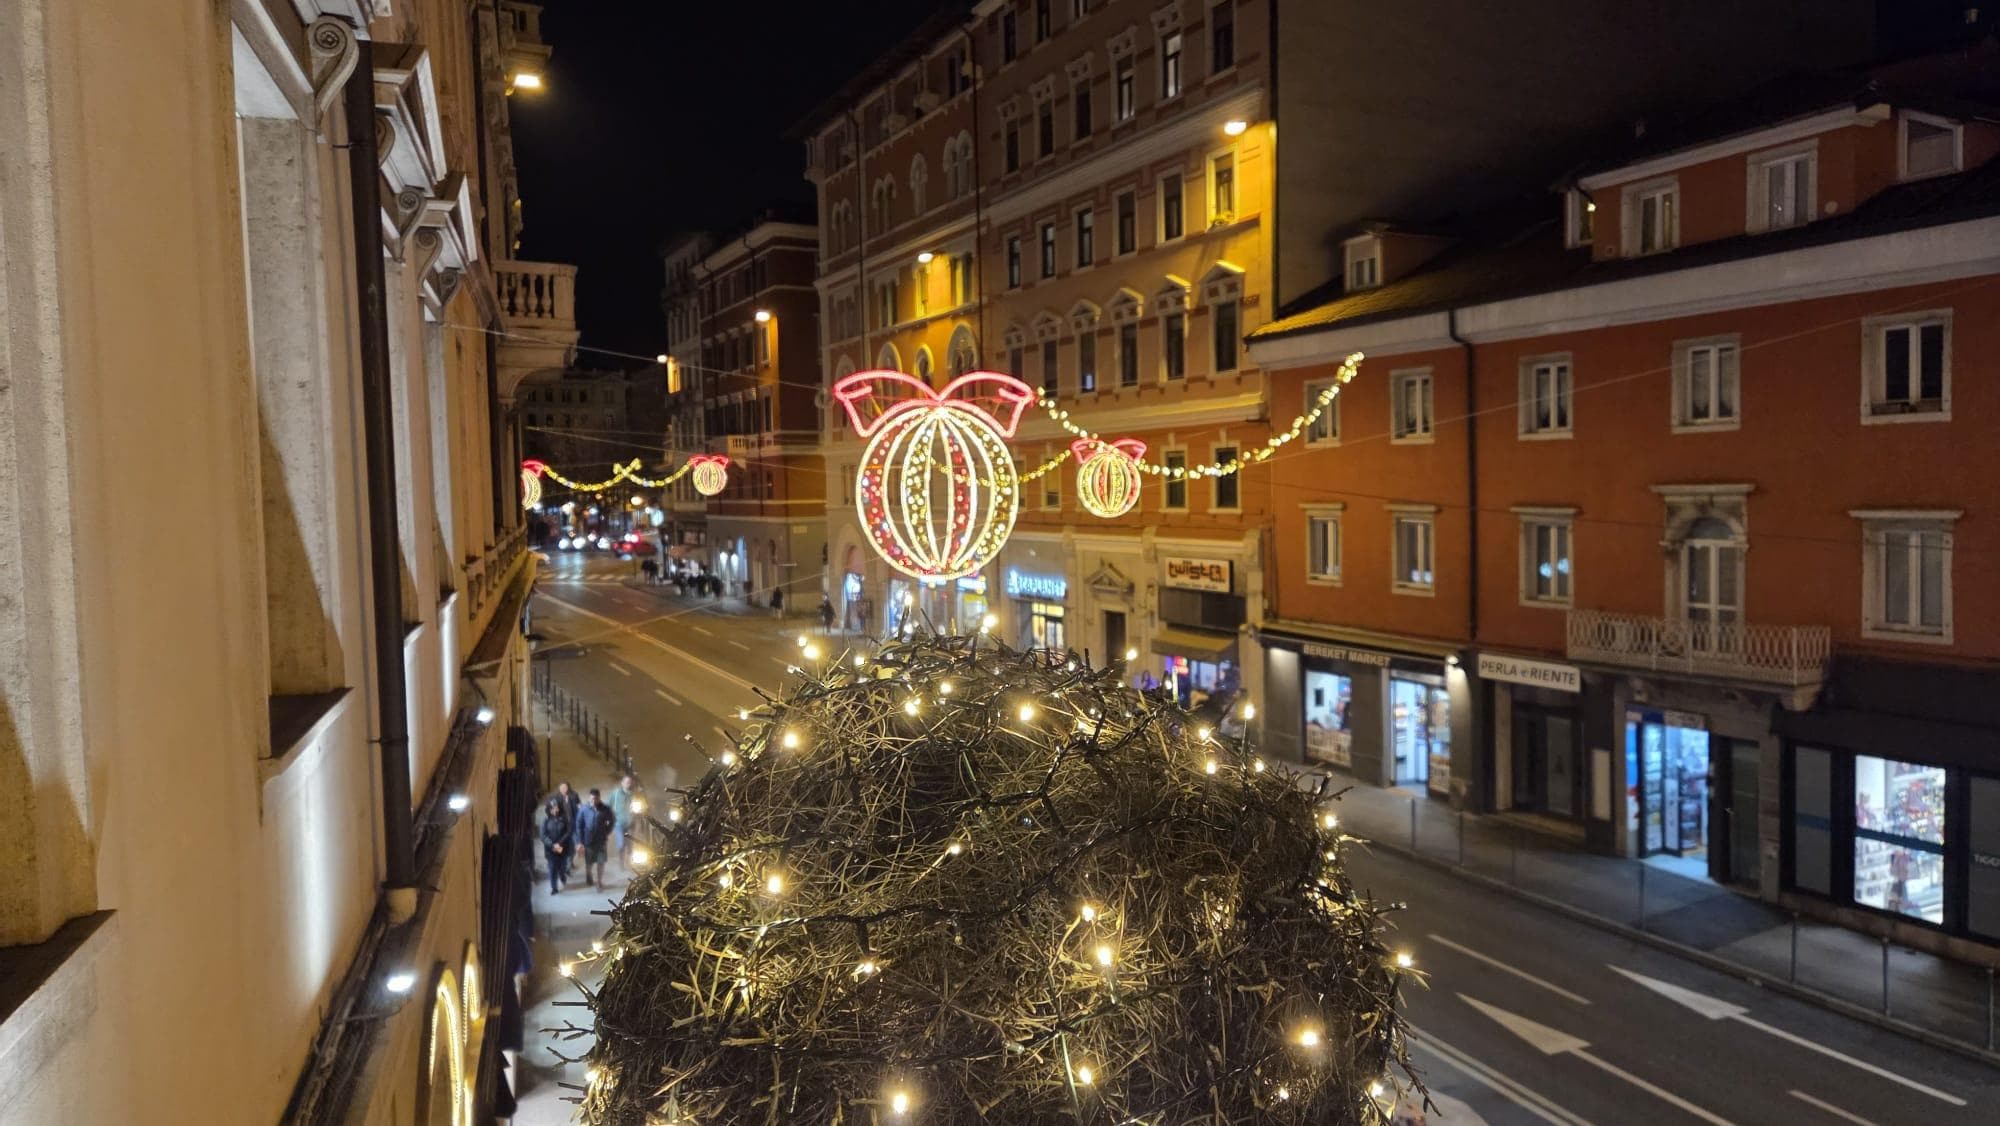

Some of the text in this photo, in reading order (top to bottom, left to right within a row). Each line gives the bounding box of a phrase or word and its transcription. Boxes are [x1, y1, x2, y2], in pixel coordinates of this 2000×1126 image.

[1303, 643, 1391, 668] BEREKET MARKET
[1481, 661, 1518, 676] PERLA
